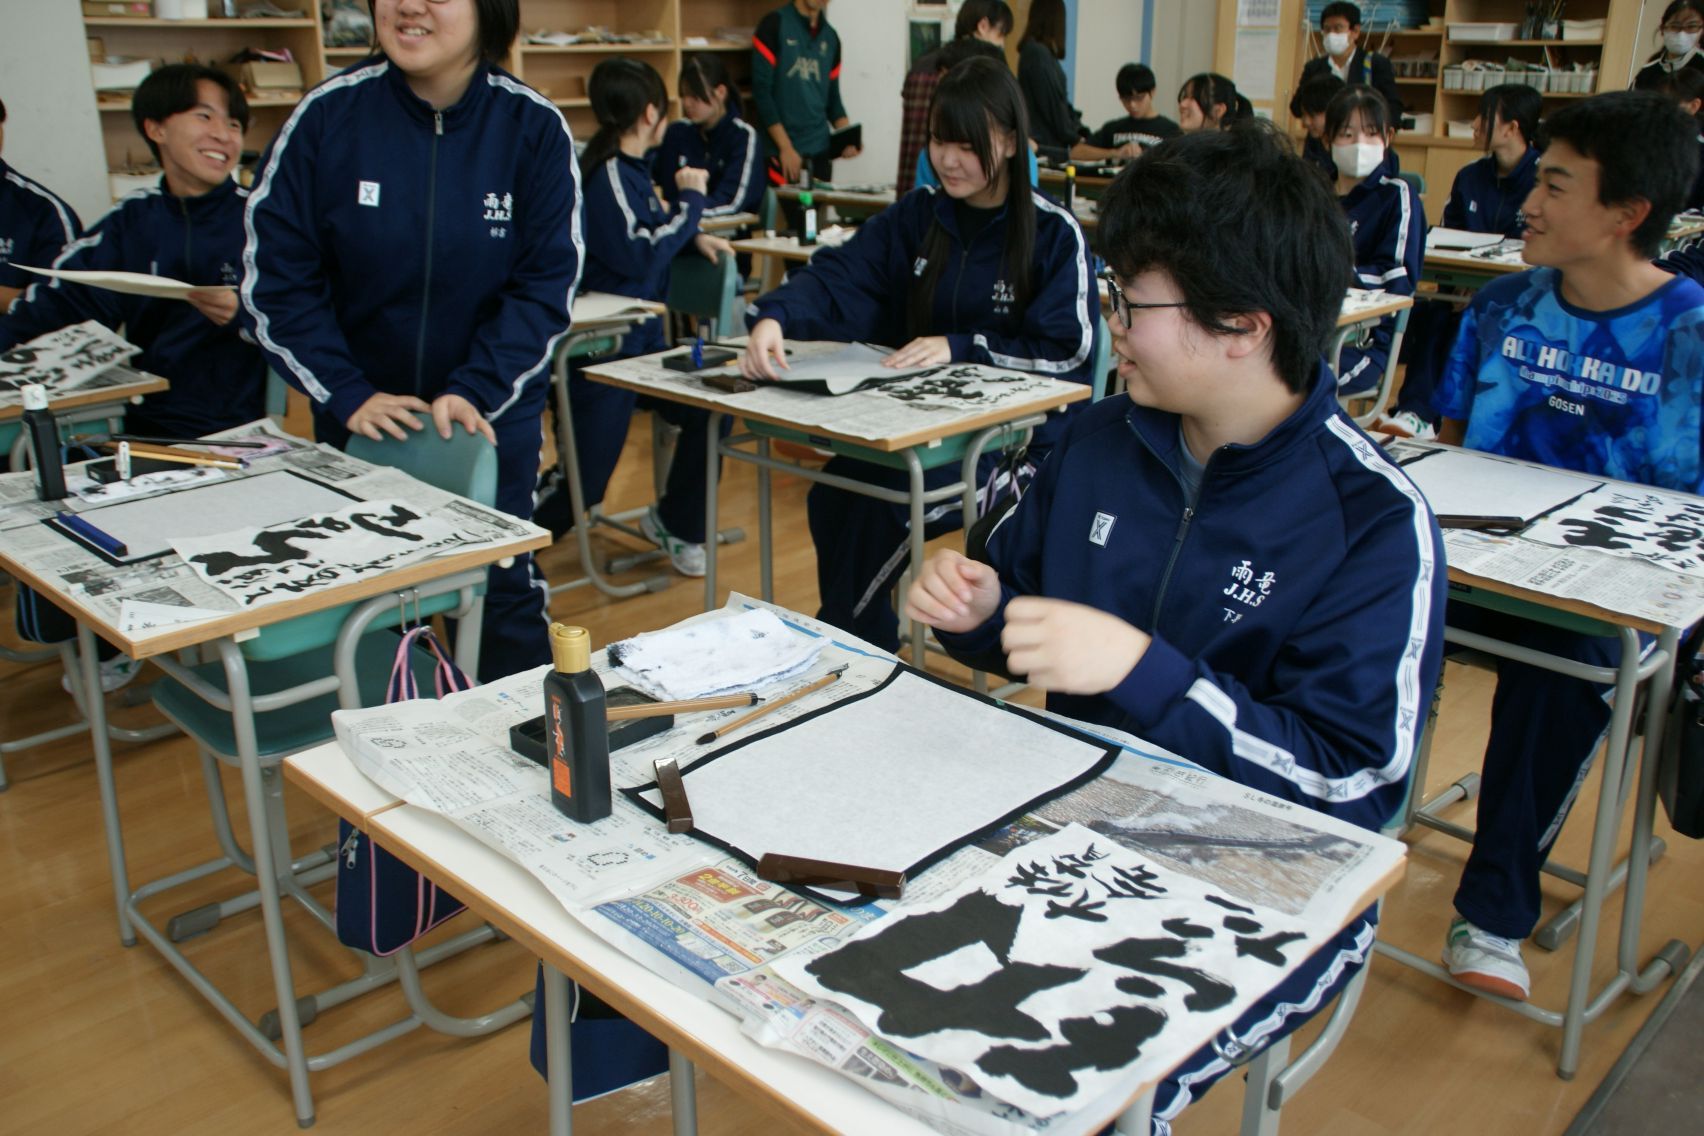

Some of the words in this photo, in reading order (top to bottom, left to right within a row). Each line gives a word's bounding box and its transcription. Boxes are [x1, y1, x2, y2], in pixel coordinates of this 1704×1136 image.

[1502, 335, 1535, 364] ALL
[1537, 345, 1662, 396] HOKKAIDO
[1548, 395, 1586, 416] GOSEN
[1223, 582, 1266, 607] J.H.S
